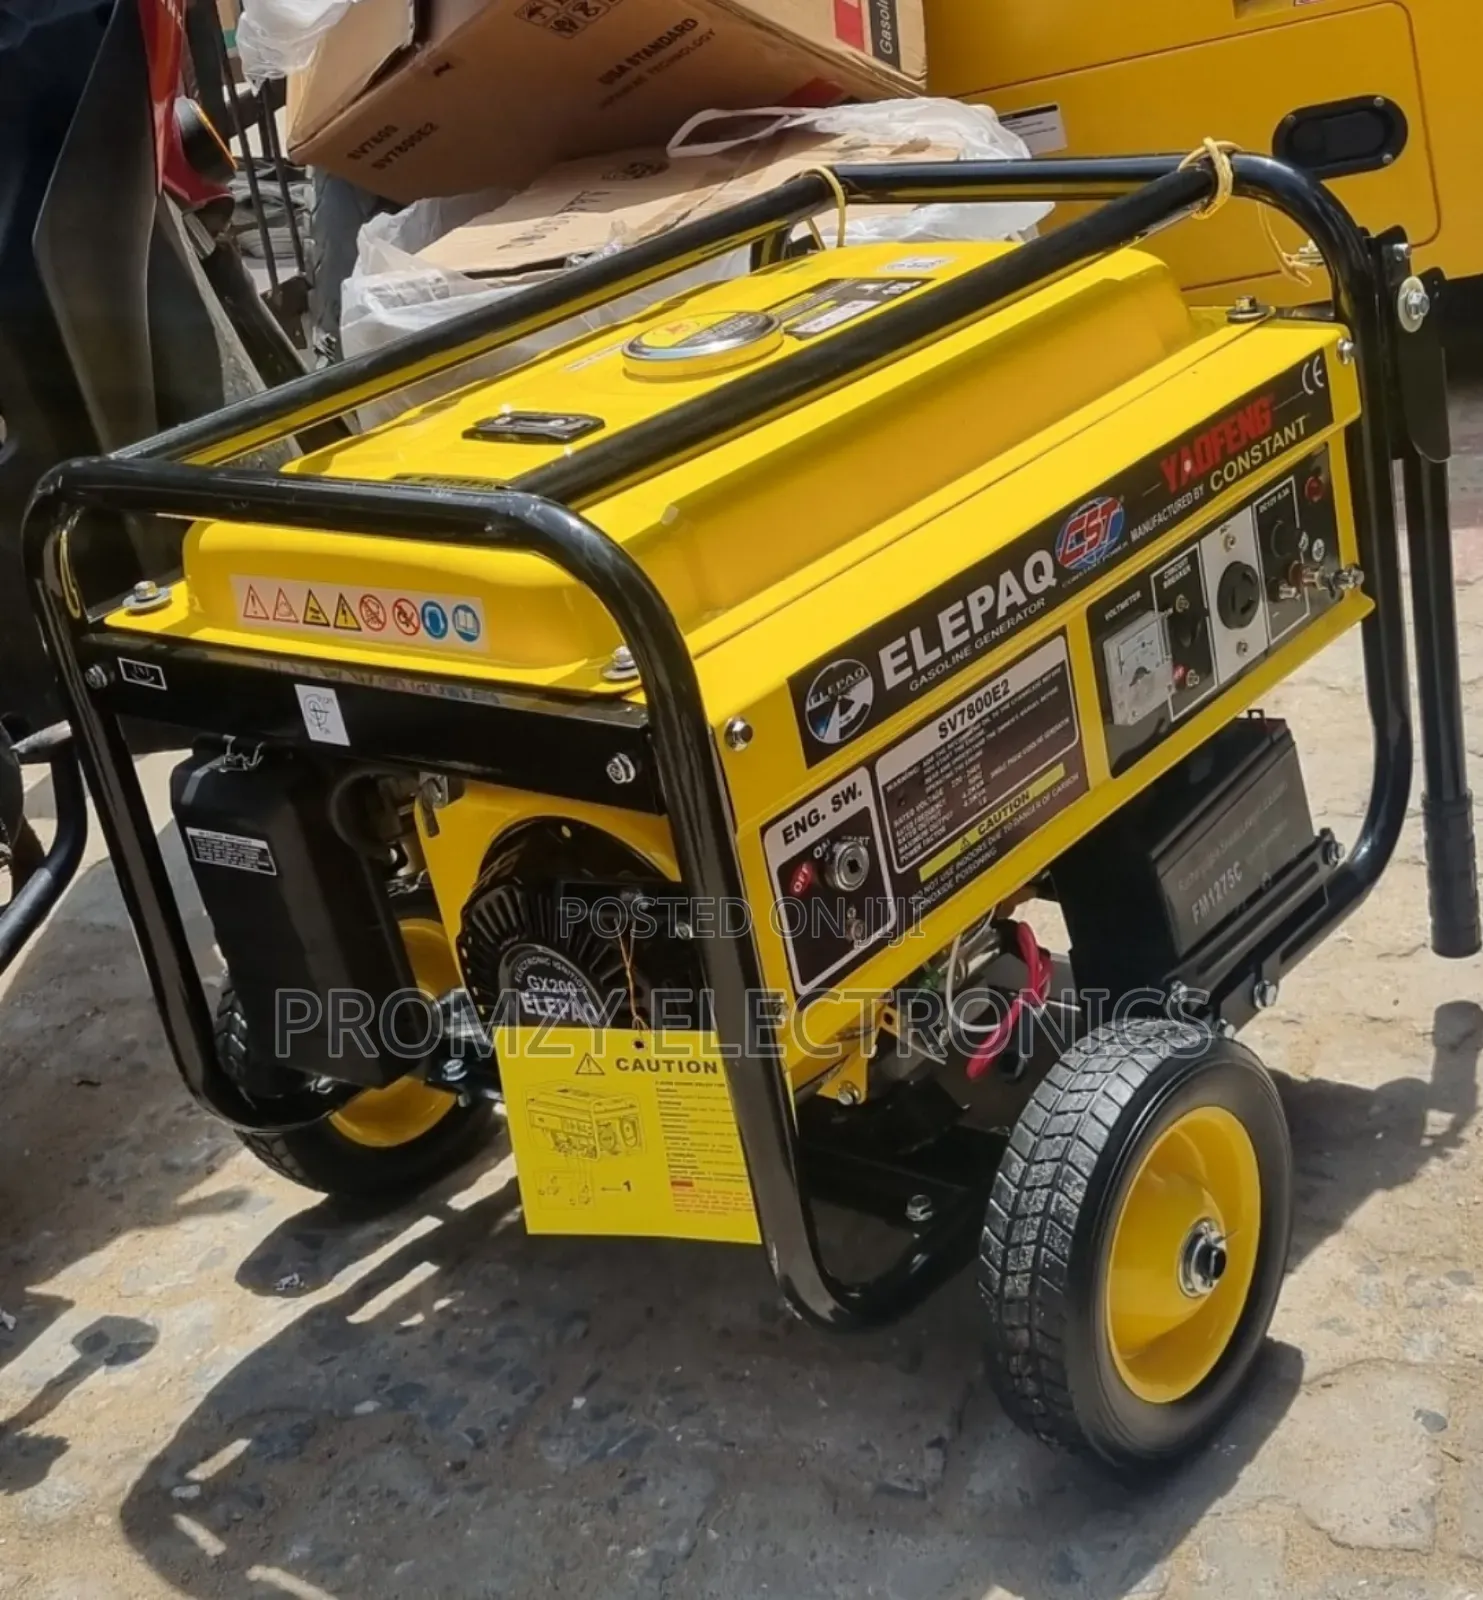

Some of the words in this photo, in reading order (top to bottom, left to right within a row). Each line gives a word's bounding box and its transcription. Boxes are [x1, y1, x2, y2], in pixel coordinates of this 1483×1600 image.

[625, 18, 698, 66] STANDARD
[1160, 394, 1275, 494] YAOFENG
[1130, 494, 1193, 542] MANUFACTURED
[1192, 484, 1205, 505] BY
[1209, 414, 1309, 492] CONSTANT
[878, 549, 1057, 691] ELEPAQ
[908, 649, 972, 692] GASOLINE
[974, 597, 1046, 649] GENERATOR
[937, 678, 1012, 740] SV7800E2
[782, 808, 827, 846] ENG.
[831, 782, 863, 813] SW.
[977, 789, 1031, 835] CAUTION
[615, 1057, 719, 1075] CAUTION
